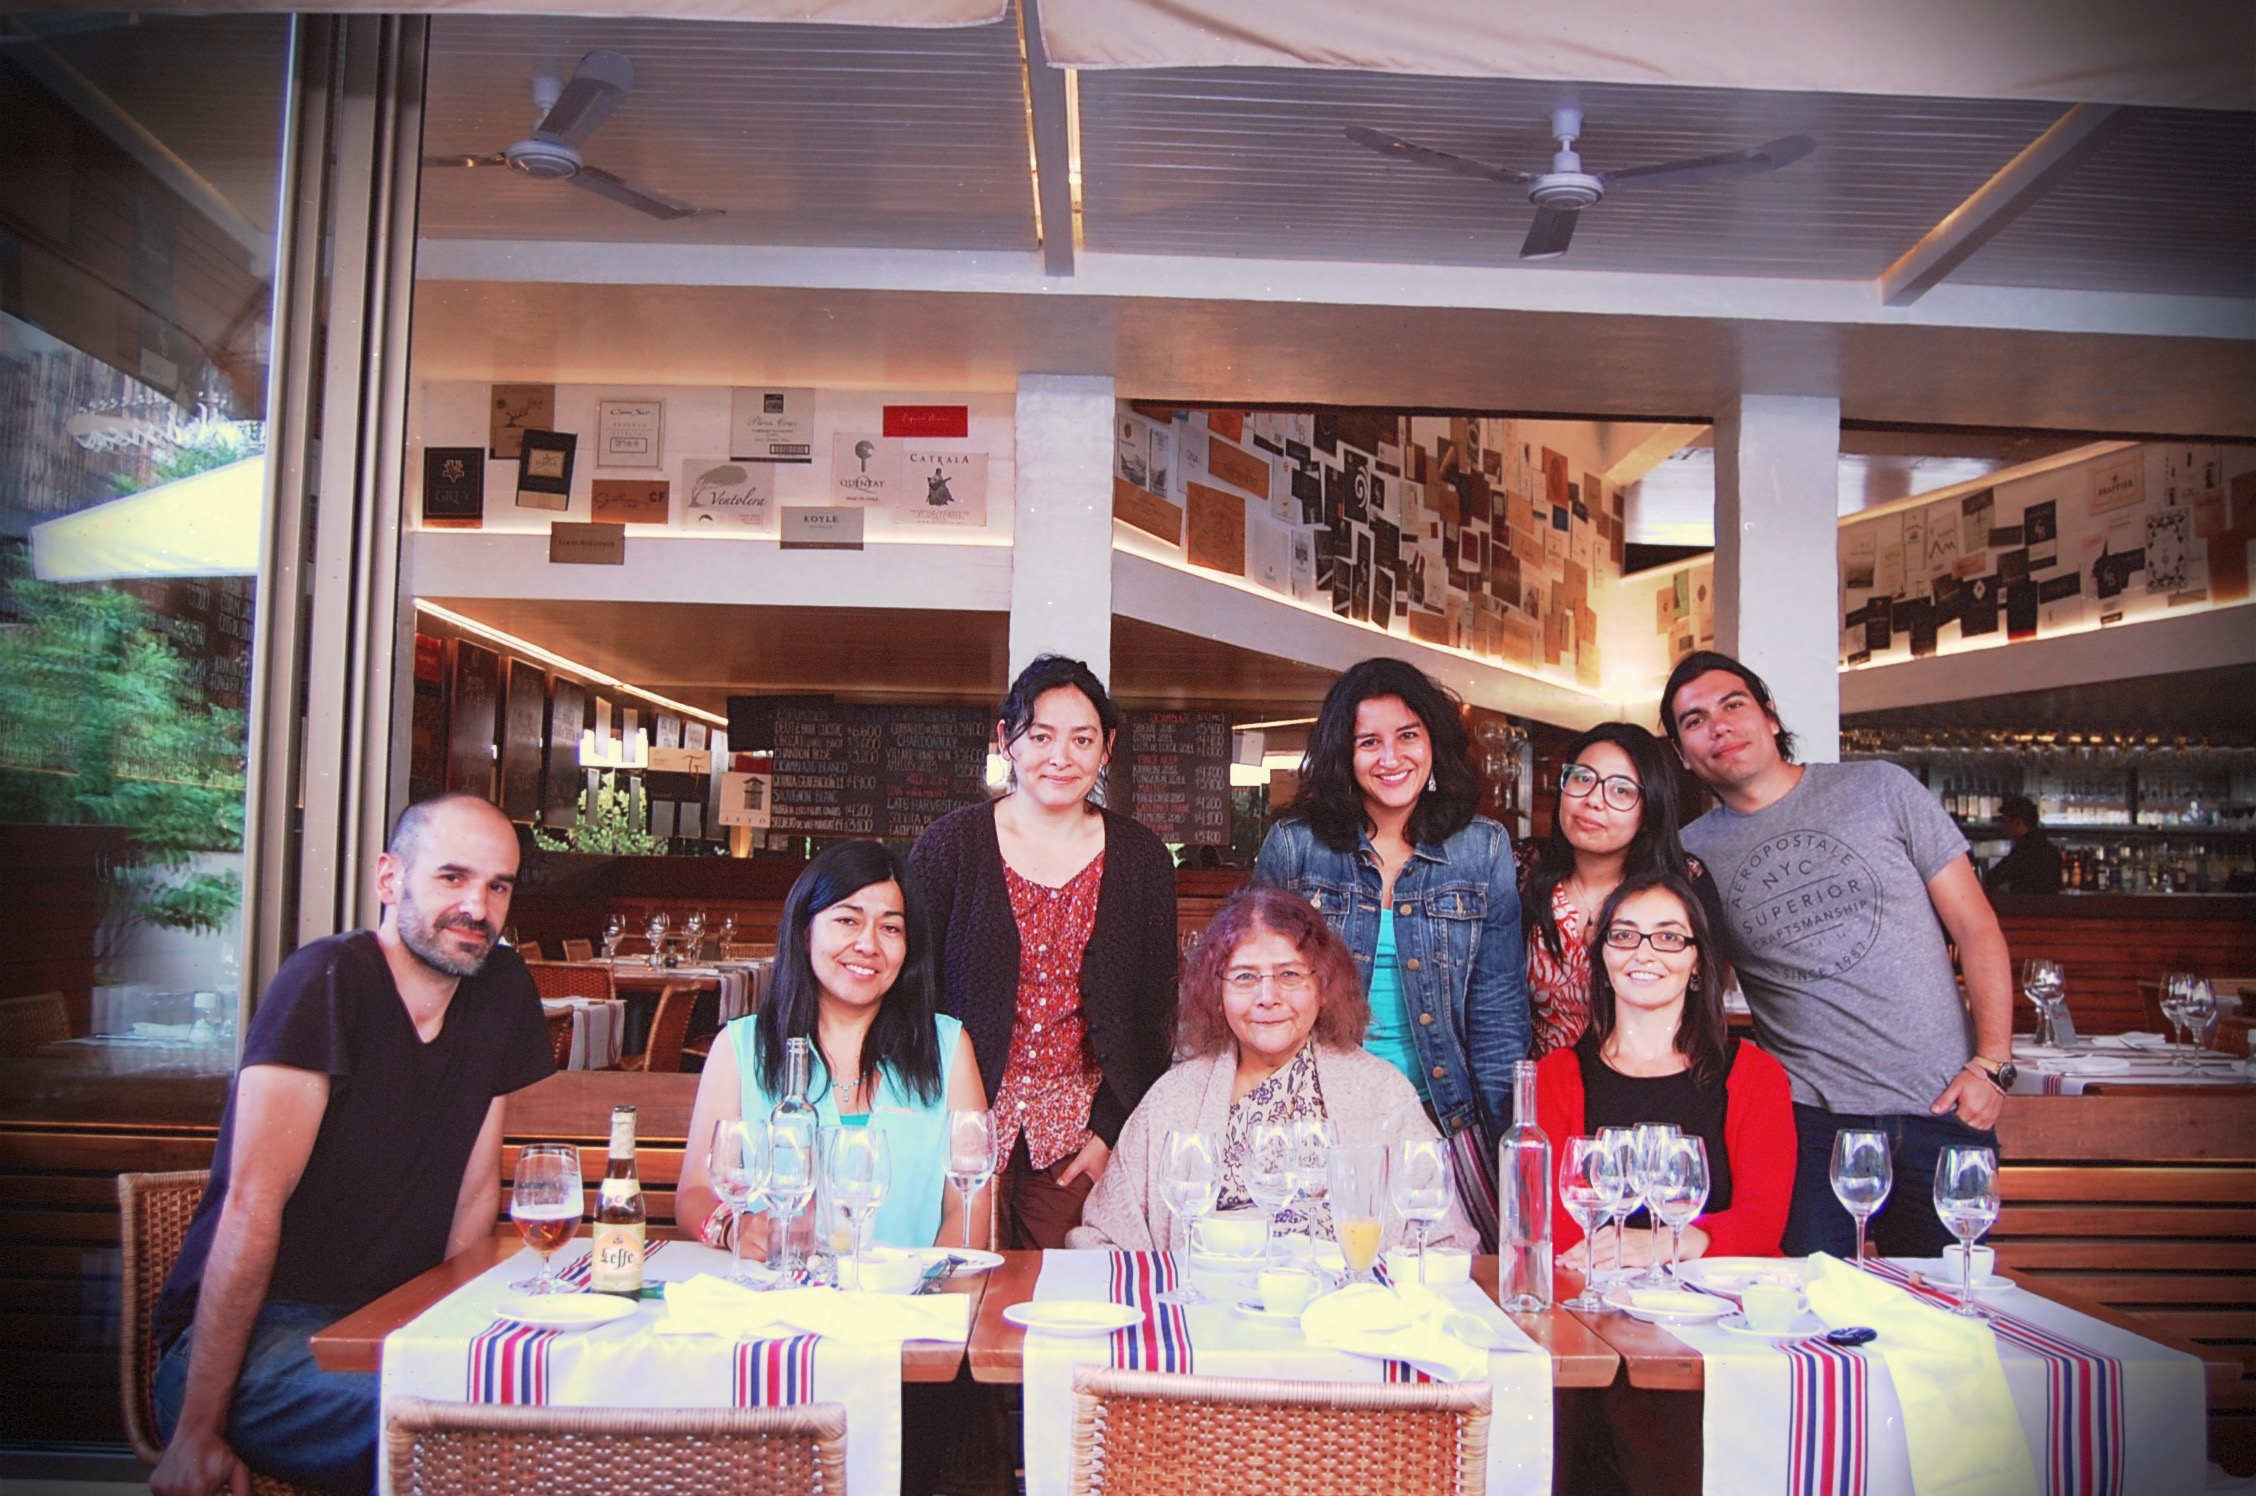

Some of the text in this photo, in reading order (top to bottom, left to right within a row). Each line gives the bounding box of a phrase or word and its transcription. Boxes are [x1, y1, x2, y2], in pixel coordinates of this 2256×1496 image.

[910, 453, 969, 466] CATRALA
[840, 479, 885, 490] QUINTAY
[649, 491, 666, 503] CF
[711, 487, 766, 507] Ventolera
[803, 515, 839, 523] KOYLE
[897, 736, 957, 749] CHARDONNAY
[886, 798, 909, 810] LATE
[911, 799, 953, 812] HARVEST
[1732, 834, 1856, 910] AEROPOSTALE
[1762, 859, 1812, 890] NYC
[1742, 879, 1861, 935] SUPERIOR
[1752, 899, 1868, 951] CRAFTSMANSHIP
[1782, 941, 1867, 981] SINCE 1987
[600, 1247, 634, 1269] Leffe
